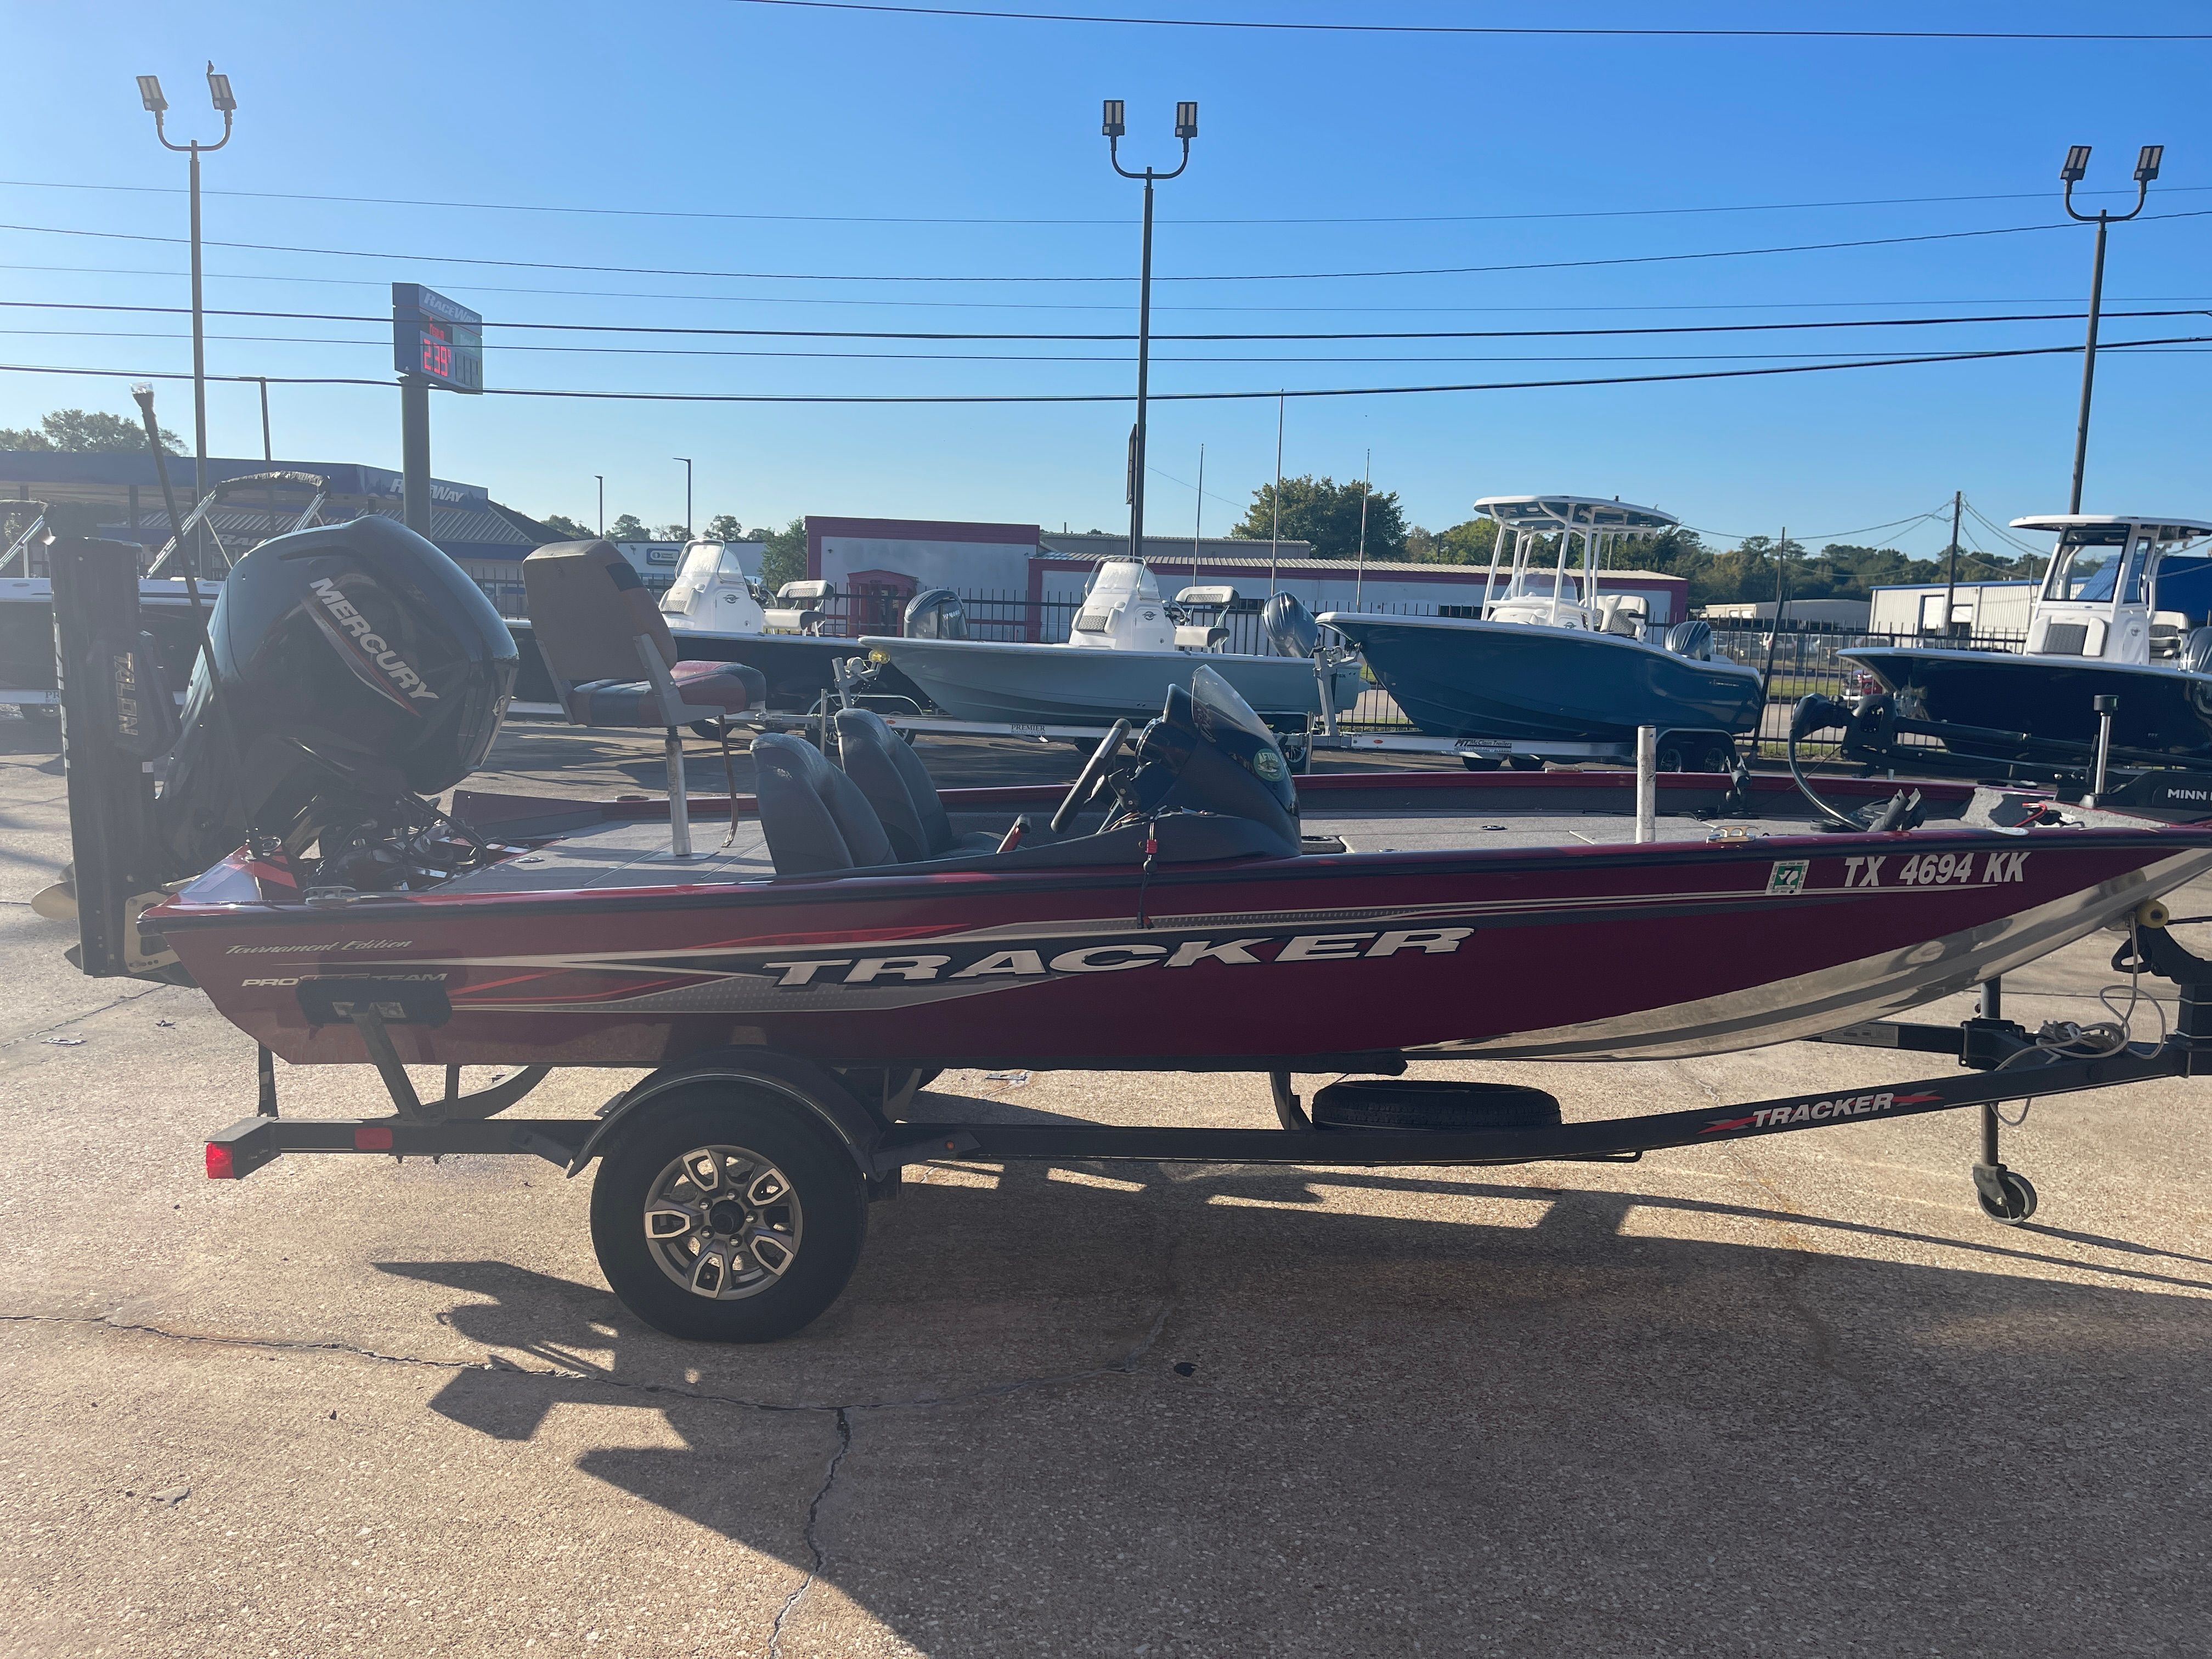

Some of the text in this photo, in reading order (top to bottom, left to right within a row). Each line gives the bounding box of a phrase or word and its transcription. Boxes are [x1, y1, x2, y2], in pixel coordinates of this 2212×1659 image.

[309, 578, 439, 699] MERCURY
[114, 652, 138, 736] TALON
[2168, 788, 2207, 800] MINN
[1844, 856, 1886, 887] TX
[1899, 853, 1974, 885] 4694
[1982, 852, 2032, 883] KK
[226, 939, 413, 954] Tournament Edition
[763, 927, 1475, 985] TRACKER
[241, 978, 299, 987] PRO
[1752, 1092, 1894, 1128] TRACKER
